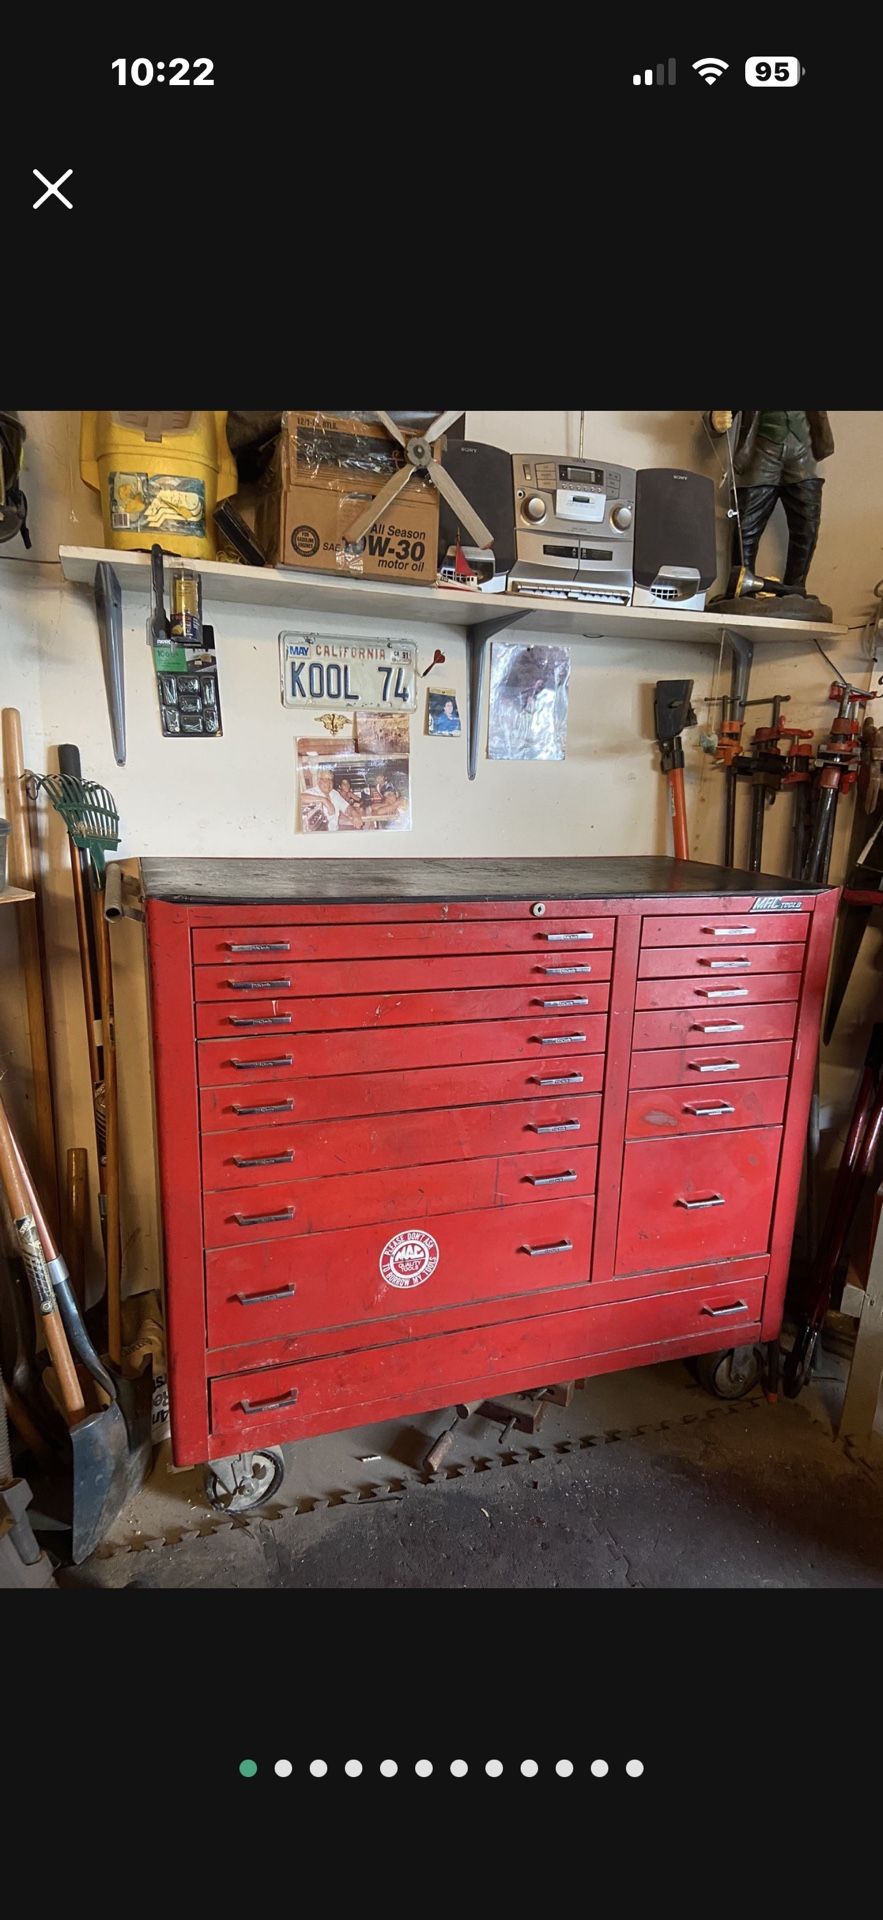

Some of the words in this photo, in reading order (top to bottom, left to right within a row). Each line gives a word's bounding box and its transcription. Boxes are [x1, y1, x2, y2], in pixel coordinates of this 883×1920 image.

[370, 523, 385, 535] All
[387, 526, 426, 541] Season
[377, 559, 409, 570] motor
[411, 561, 425, 572] oil
[289, 645, 309, 657] MAY
[315, 644, 386, 661] CALIFORNIA
[290, 661, 359, 700] KOOL
[377, 666, 410, 702] 74
[752, 896, 782, 909] MAC
[781, 901, 802, 909] TOOLS
[384, 1235, 404, 1256] PLEASE
[423, 1236, 435, 1250] ASK
[394, 1244, 425, 1261] MAC
[382, 1264, 391, 1273] TO
[423, 1256, 437, 1276] TOOLS
[386, 1272, 410, 1286] BORROW
[412, 1275, 423, 1285] MY
